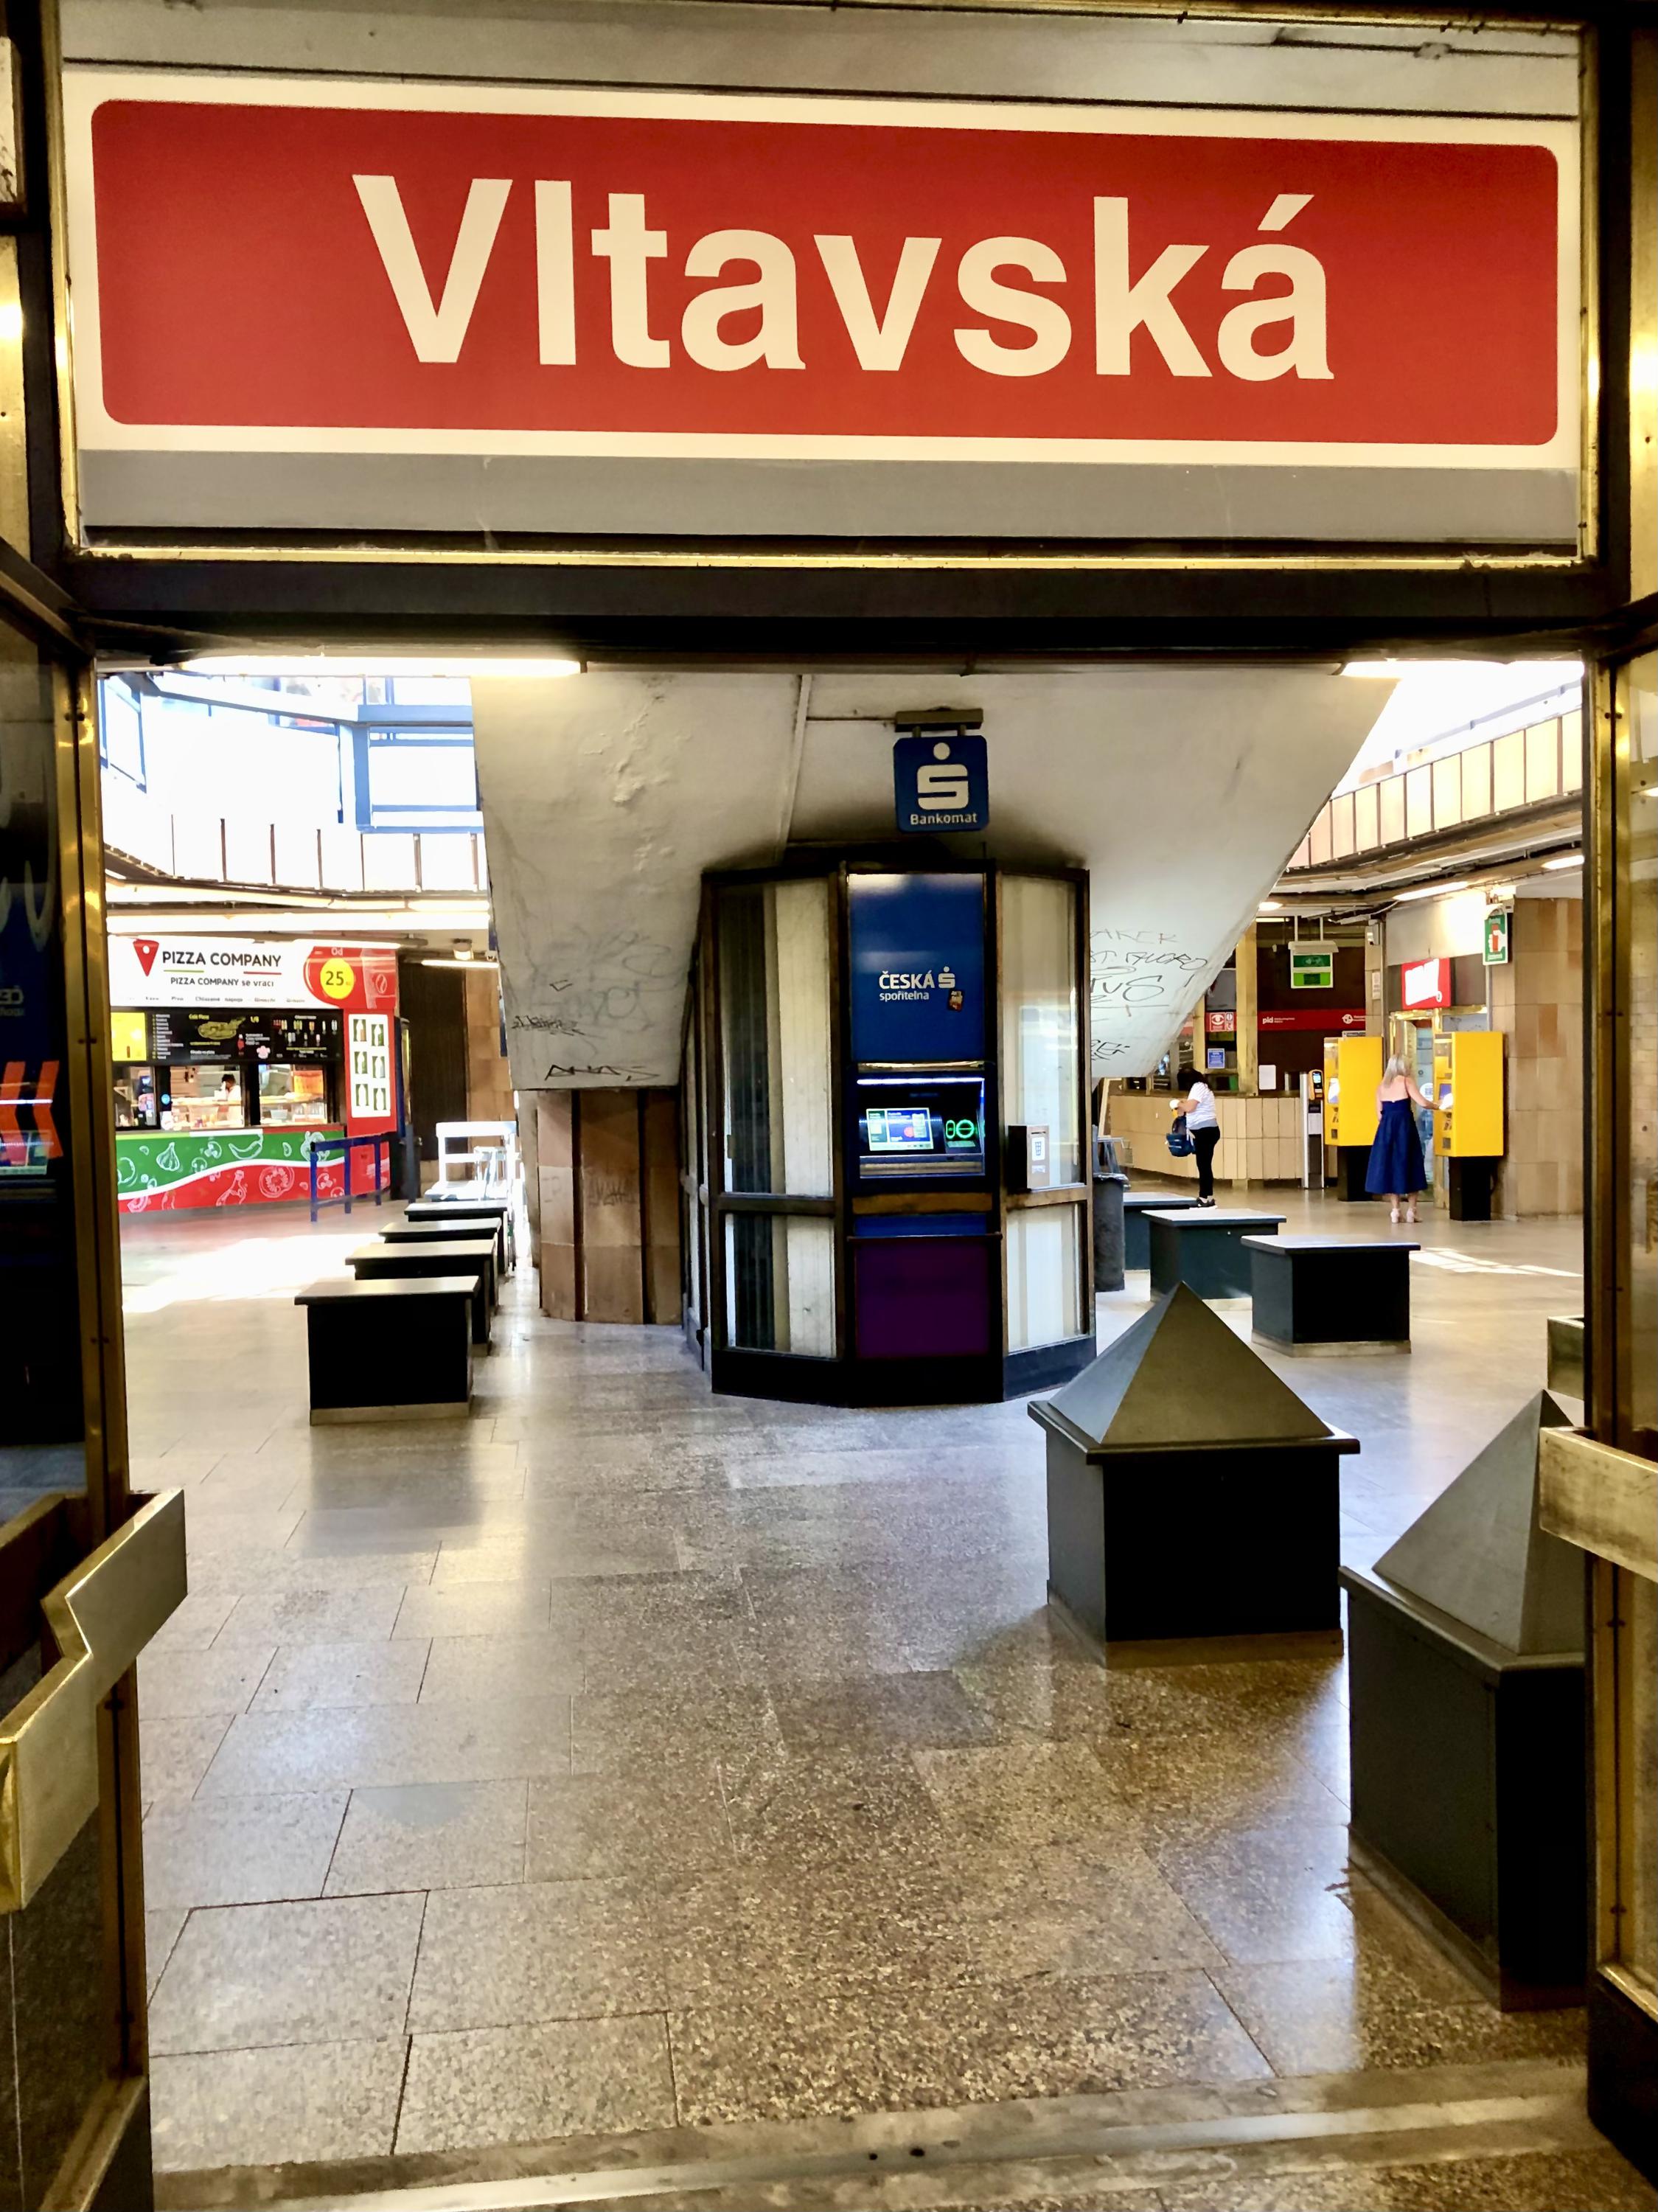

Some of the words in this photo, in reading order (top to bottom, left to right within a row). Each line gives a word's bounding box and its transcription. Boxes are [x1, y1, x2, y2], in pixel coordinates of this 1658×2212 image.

[352, 175, 1334, 381] Vltavská
[910, 813, 978, 825] Bankomat
[161, 950, 206, 966] PIZZA
[209, 952, 282, 967] COMPANY
[170, 976, 195, 985] PIZZA
[197, 978, 240, 987] COMPANY
[324, 970, 345, 987] 25
[878, 970, 936, 990] ČESKÁ
[879, 990, 930, 1002] spořitelna
[1262, 1016, 1274, 1025] pid
